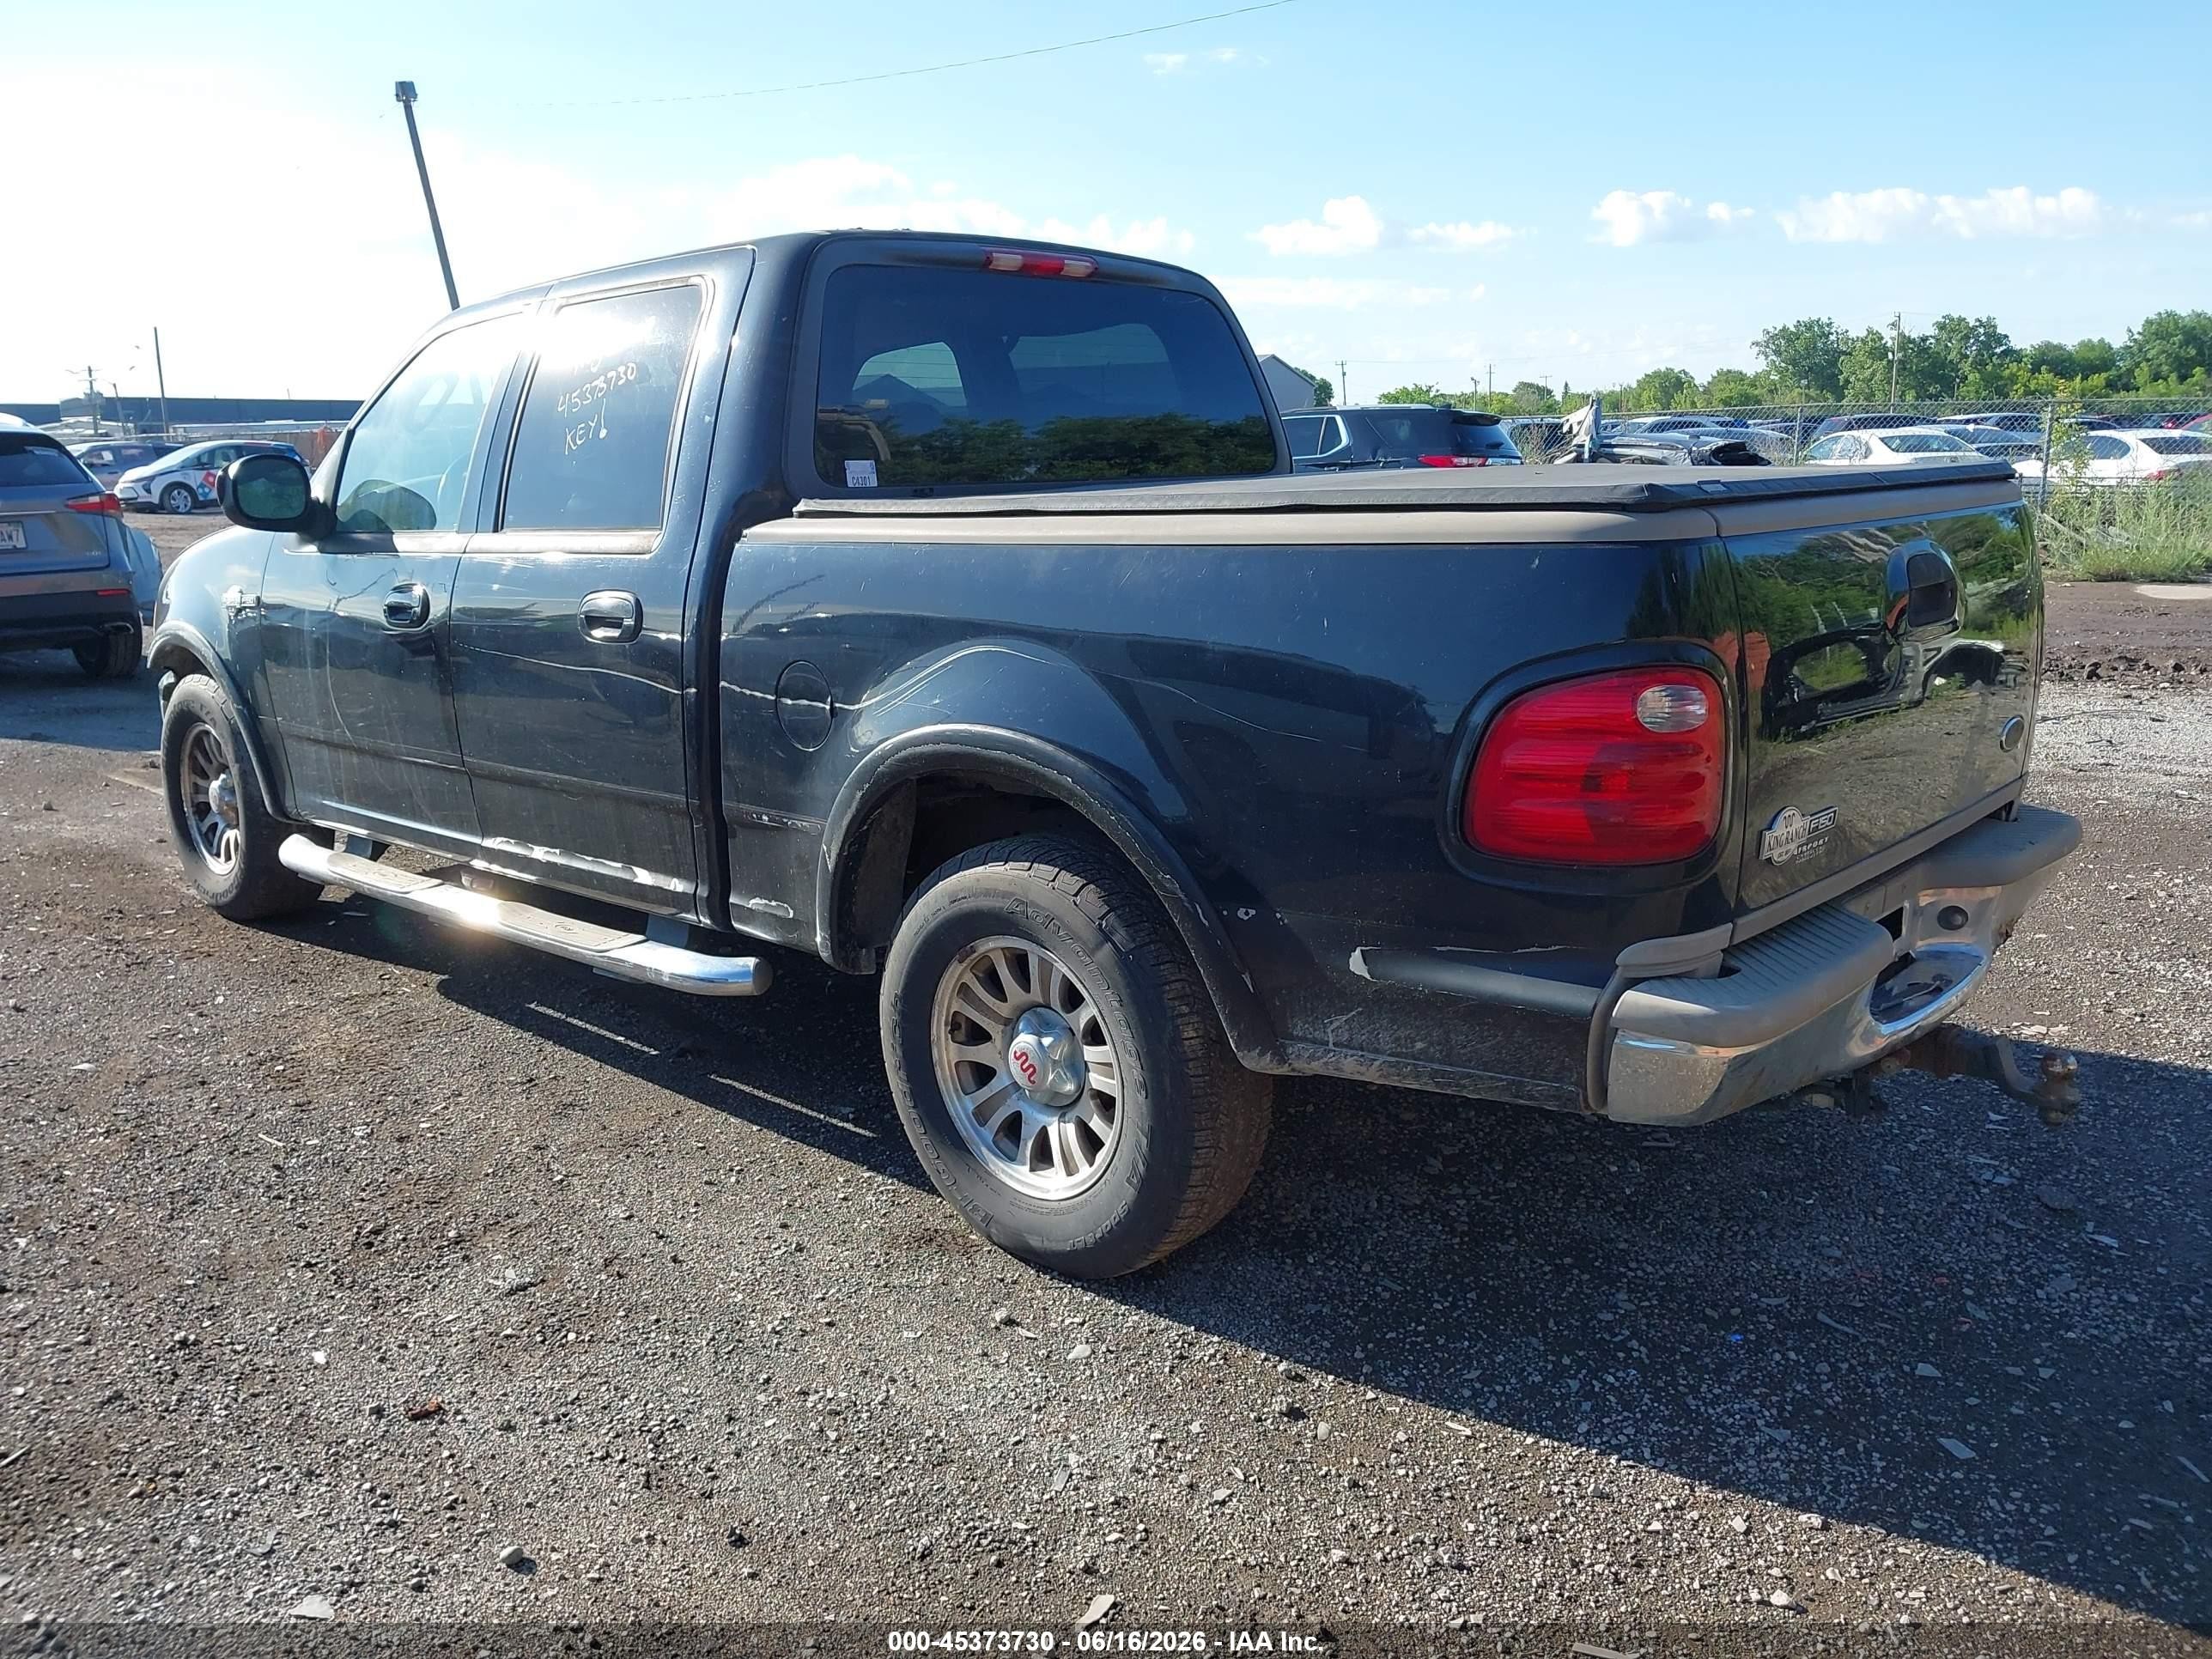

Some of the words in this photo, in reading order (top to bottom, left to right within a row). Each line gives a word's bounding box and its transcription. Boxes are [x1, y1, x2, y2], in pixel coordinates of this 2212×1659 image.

[1766, 833, 1784, 853] KING
[1785, 820, 1808, 845] RANCH
[1809, 812, 1835, 834] F150
[1003, 896, 1149, 1101] Advantage
